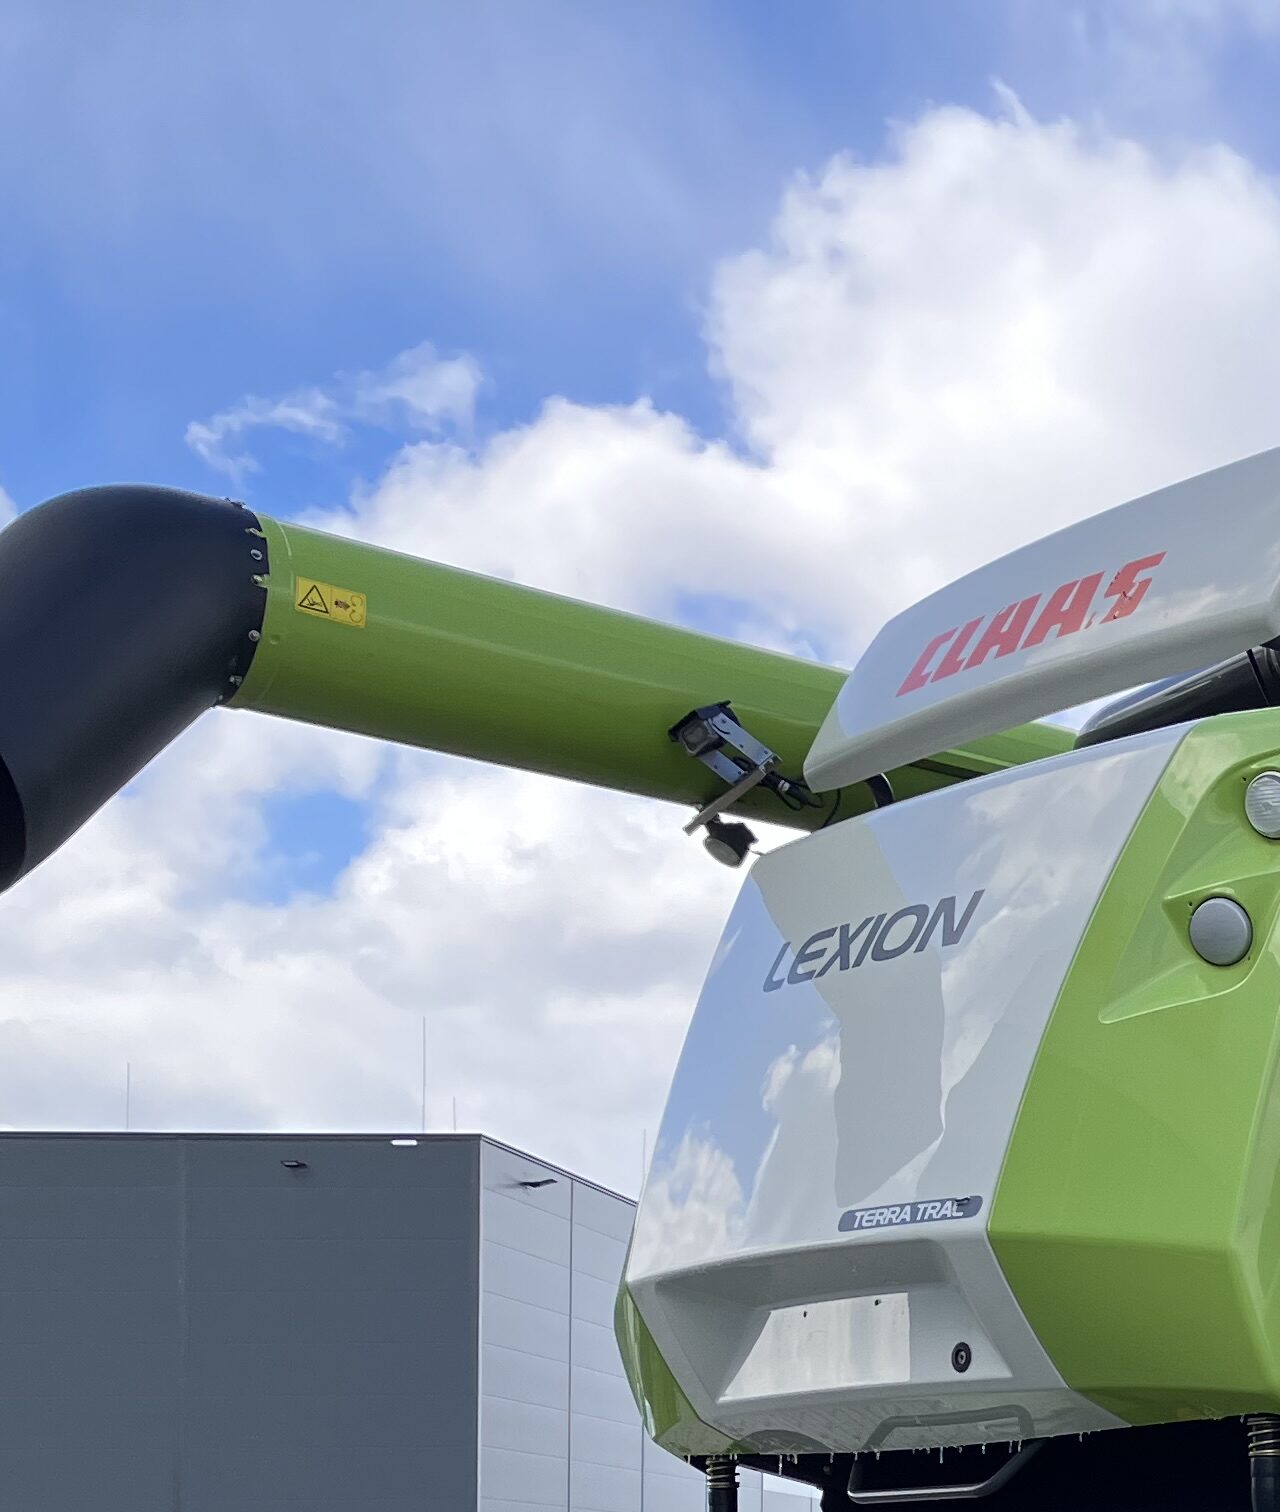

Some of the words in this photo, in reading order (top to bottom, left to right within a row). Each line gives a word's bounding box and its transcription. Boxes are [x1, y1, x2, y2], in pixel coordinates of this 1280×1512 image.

[895, 551, 1168, 698] CLAAS
[762, 889, 985, 993] LEXION
[853, 1205, 911, 1229] TERRA
